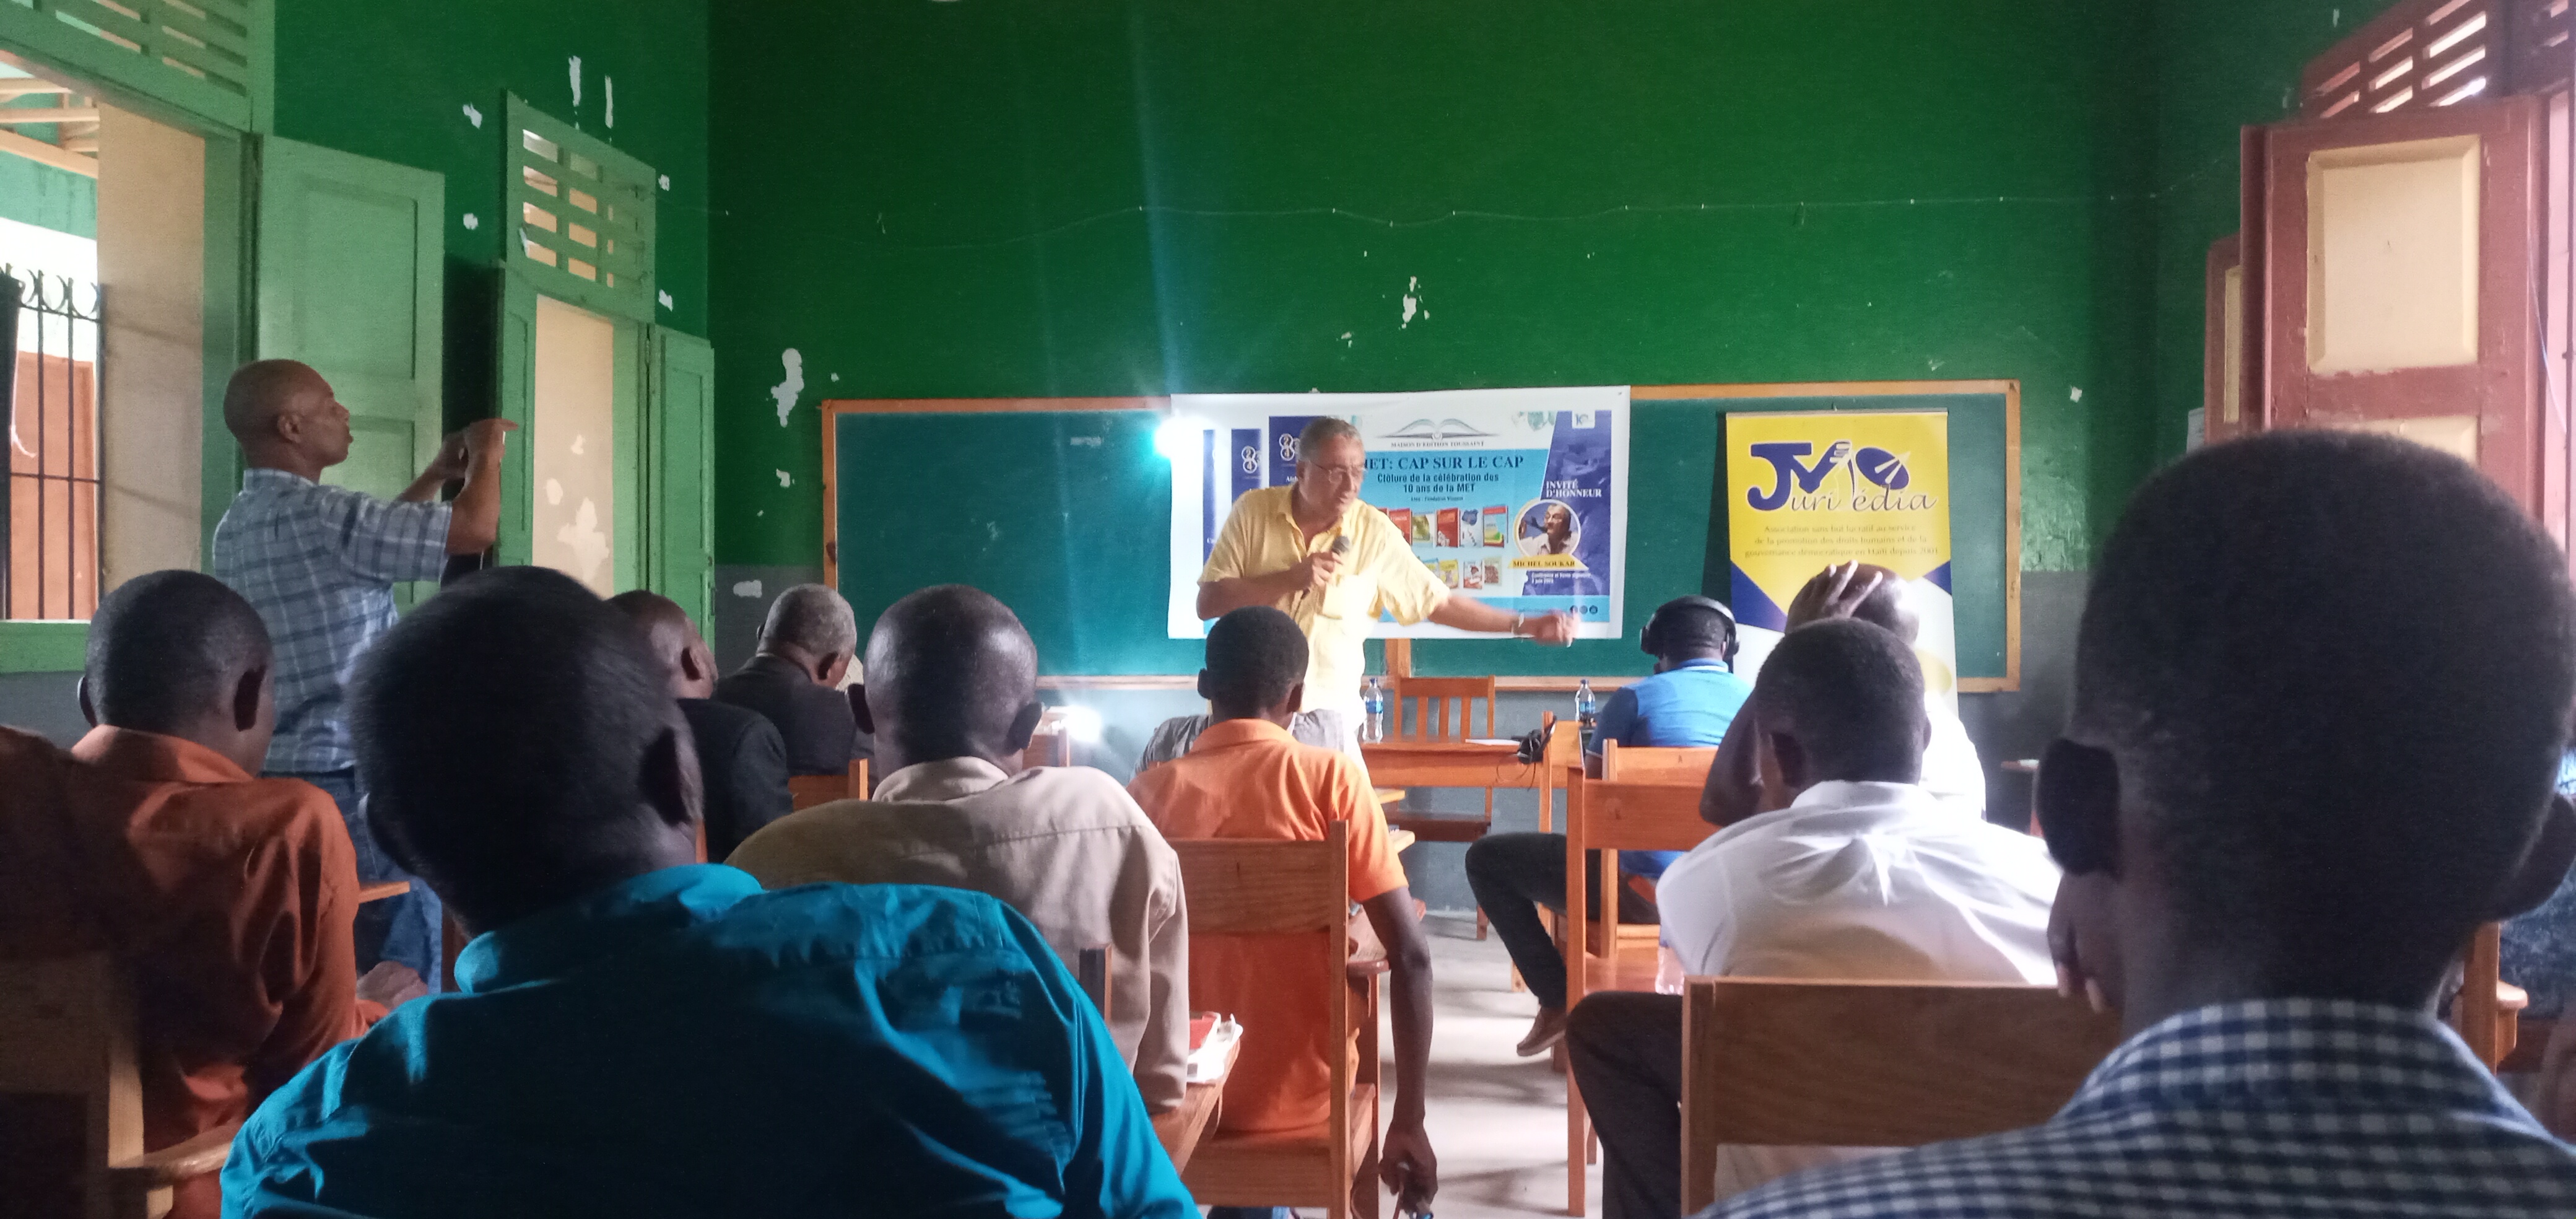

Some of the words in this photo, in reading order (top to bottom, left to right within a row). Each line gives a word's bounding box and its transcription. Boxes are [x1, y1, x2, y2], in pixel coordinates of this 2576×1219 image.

[1364, 458, 1393, 470] ET:
[1398, 457, 1429, 470] CAP
[1433, 457, 1462, 470] SUR
[1468, 456, 1488, 469] LE
[1492, 455, 1523, 468] CAP
[1410, 473, 1420, 483] de
[1423, 473, 1430, 483] la
[1484, 472, 1499, 482] des
[1403, 484, 1413, 494] 10
[1416, 485, 1430, 494] ans
[1433, 484, 1443, 493] de
[1446, 483, 1454, 493] la
[1456, 483, 1475, 493] MET
[1546, 479, 1578, 489] INVITÉ
[1546, 489, 1602, 498] D'HONNEUR
